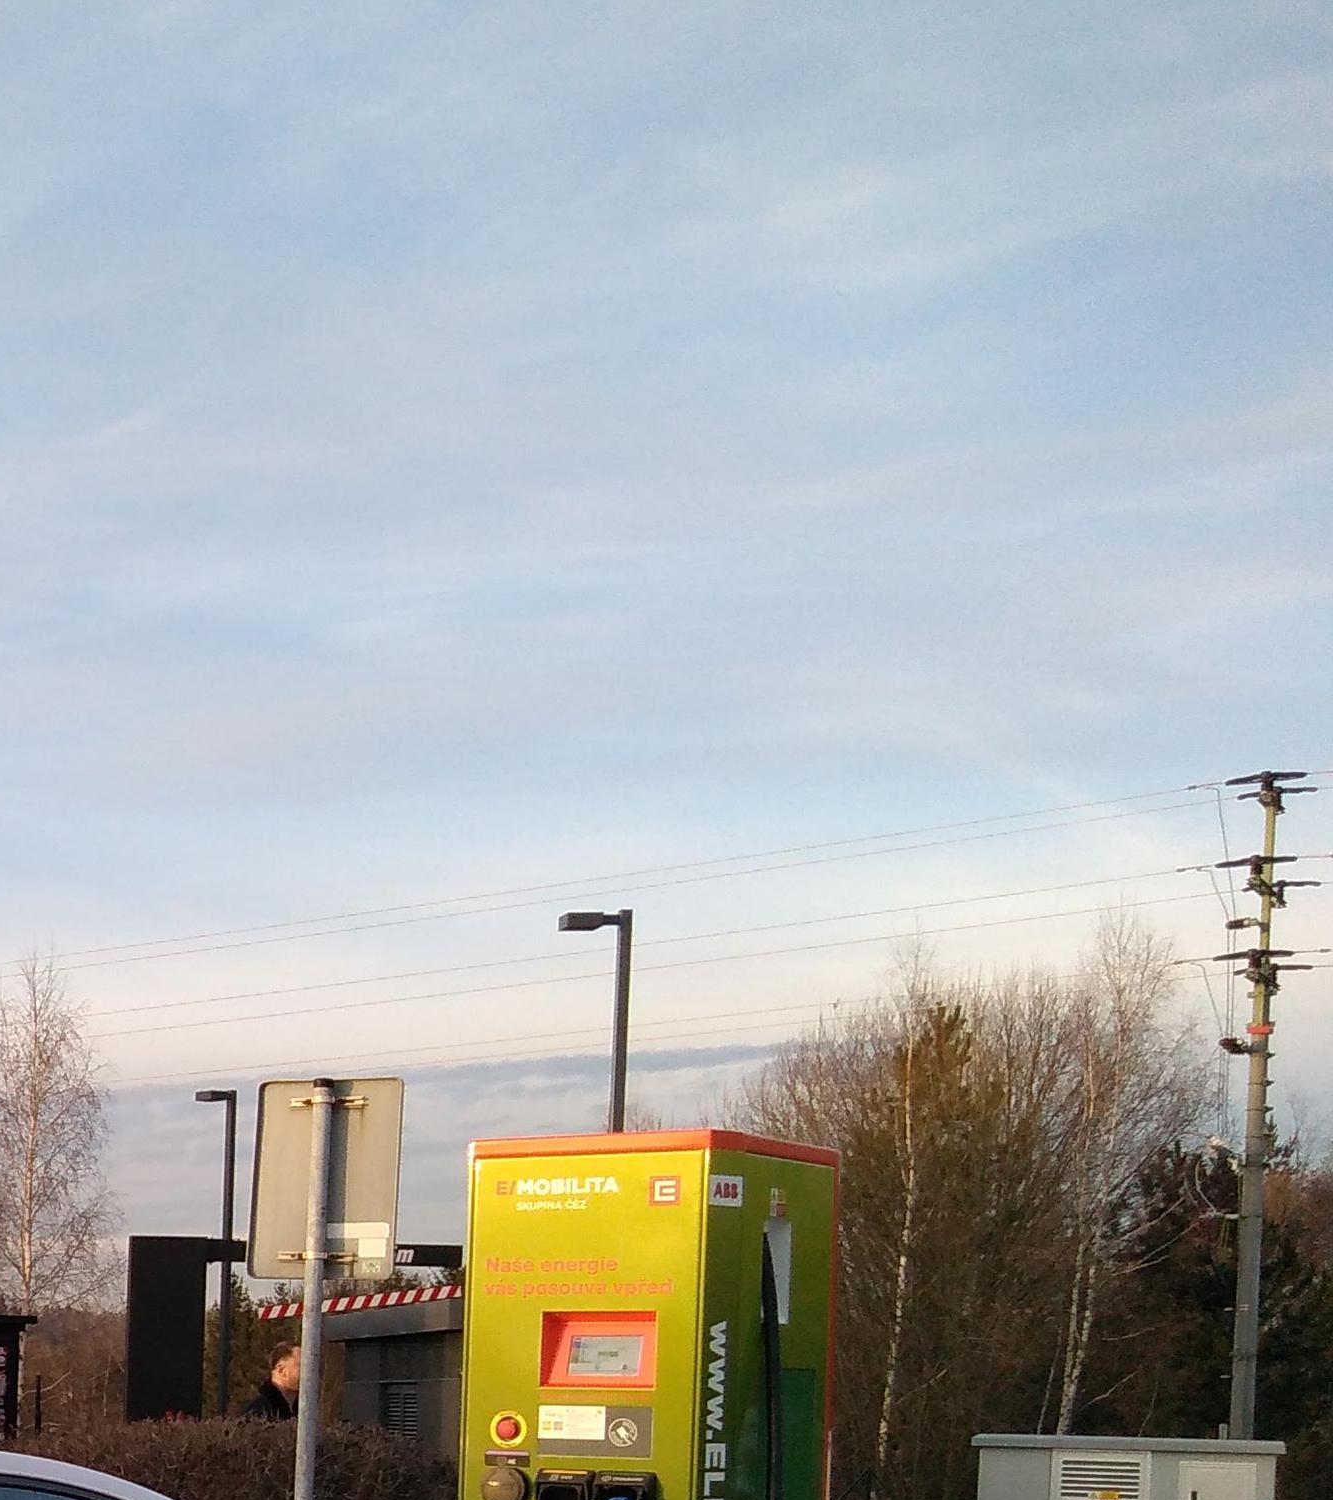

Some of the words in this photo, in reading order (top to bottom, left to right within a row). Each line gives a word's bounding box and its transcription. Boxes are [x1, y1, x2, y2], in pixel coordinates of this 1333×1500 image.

[713, 1182, 738, 1200] ABB
[516, 1200, 562, 1212] SKUPINA
[565, 1198, 587, 1210] ČEZ
[485, 1256, 534, 1273] Naše
[540, 1256, 619, 1275] energie
[484, 1280, 517, 1296] vás
[613, 1279, 673, 1297] vpřed
